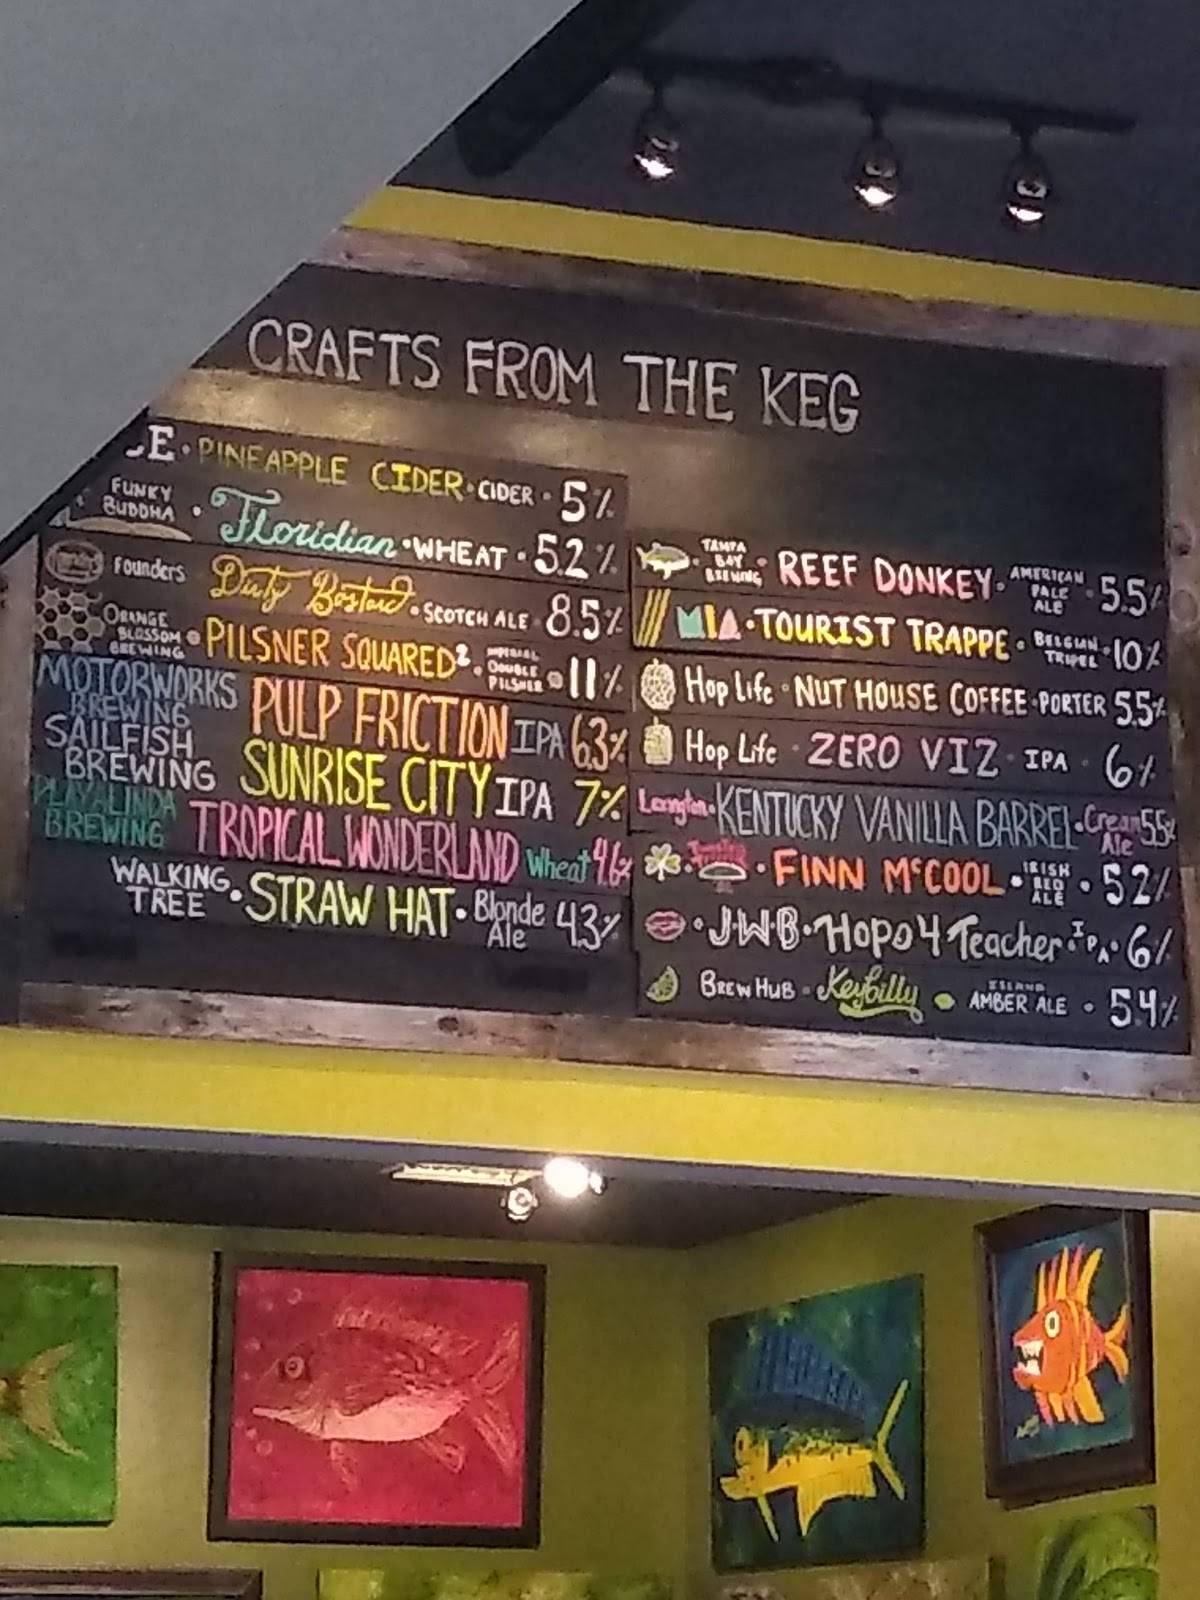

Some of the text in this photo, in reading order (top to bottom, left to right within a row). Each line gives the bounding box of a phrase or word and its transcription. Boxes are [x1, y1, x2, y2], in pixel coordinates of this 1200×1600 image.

[248, 318, 861, 434] CRAFTS FROM THE KEG
[198, 437, 464, 501] PINEAPPLE CIDER
[111, 477, 172, 501] FUNKY
[477, 479, 535, 507] CIDER
[102, 495, 175, 523] BUDDHA
[210, 486, 398, 559] Floridian
[412, 536, 508, 571] WHEAT
[700, 537, 747, 554] TAMPA
[714, 553, 744, 569] BAY
[778, 550, 993, 601] REEF DONKEY
[1009, 566, 1085, 585] AMERICAN
[1031, 583, 1069, 600] PALE
[423, 601, 529, 630] SCOTCH ALE
[1033, 600, 1064, 615] ALE
[206, 616, 331, 668] PILSNER
[754, 607, 1011, 661] TOURIST TRAPPE
[1033, 629, 1099, 652] BELGIAN
[36, 654, 239, 710] MOTORWORKS
[684, 664, 774, 707] Hop Life
[794, 674, 847, 710] NUT
[949, 681, 1028, 716] COFFEE
[69, 691, 191, 728] BREWING
[253, 676, 510, 760] PULP FRICTION
[1038, 690, 1107, 717] PORTER
[44, 713, 194, 759] SAILFISH
[511, 718, 564, 760] IPA
[685, 728, 778, 771] Hop Life
[807, 731, 1000, 778] ZERO VIZ
[65, 746, 216, 792] BREWING
[239, 738, 493, 819] SUNRISE CITY
[1023, 749, 1069, 772] IPA
[494, 777, 553, 821] IPA
[574, 778, 627, 827] 7%
[715, 781, 1079, 850] KENTUCKY VANILLA BARREL
[45, 807, 165, 849] BREWING
[1084, 804, 1142, 834] Cream
[189, 799, 520, 884] TROPICAL WONDERLAND
[1100, 831, 1134, 857] Ale
[110, 855, 230, 892] WALKING
[524, 848, 591, 884] Wheat
[773, 847, 866, 892] FINN
[1022, 861, 1071, 878] IRISH
[1033, 876, 1065, 892] RED
[126, 886, 206, 917] TREE
[246, 871, 456, 937] STRAW HAT
[474, 889, 546, 927] Blonde
[1031, 890, 1065, 907] ALE
[487, 922, 528, 949] Ale
[915, 913, 941, 958] 4
[946, 913, 1063, 963] Teacher
[968, 990, 1068, 1016] AMBER ALE
